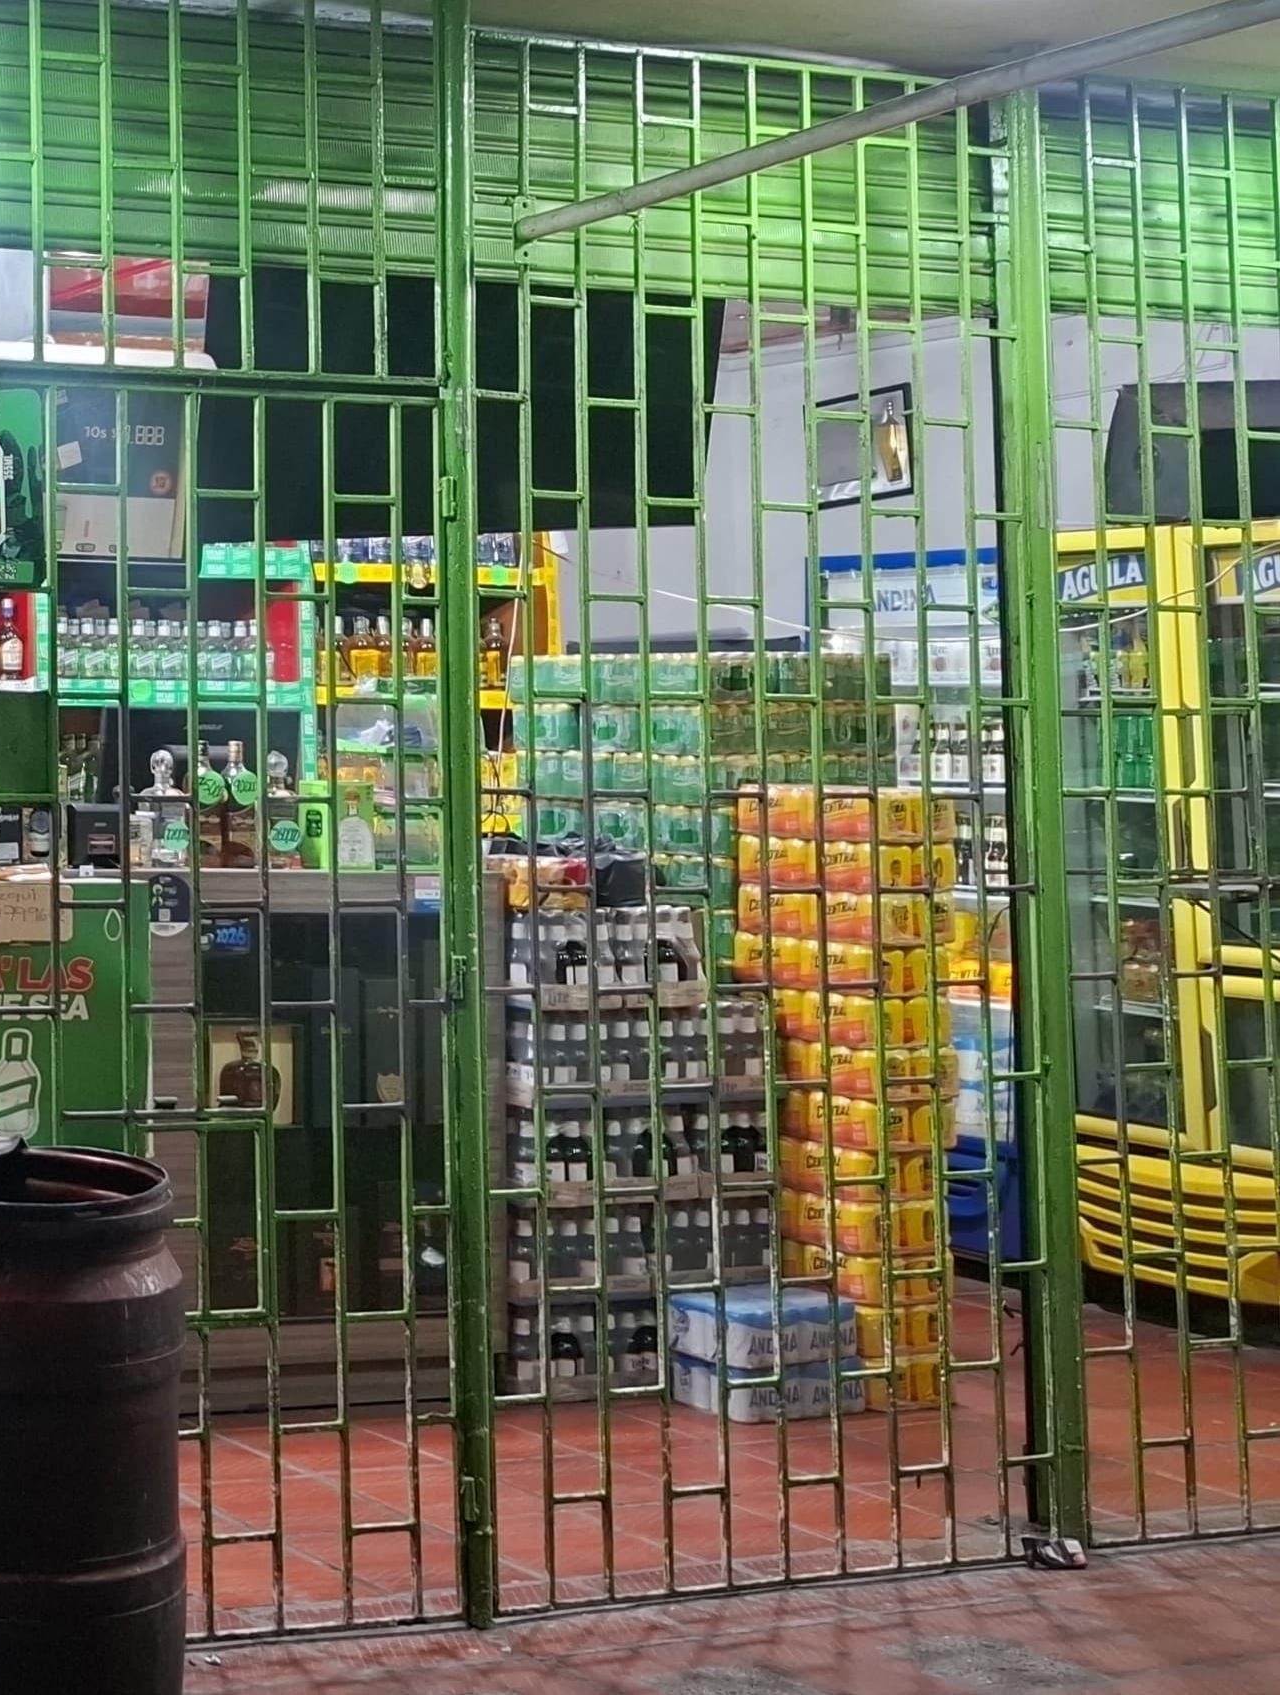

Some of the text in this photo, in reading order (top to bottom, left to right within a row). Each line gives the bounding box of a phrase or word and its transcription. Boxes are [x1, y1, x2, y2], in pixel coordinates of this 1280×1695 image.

[873, 583, 937, 613] NDIA
[747, 1328, 799, 1356] ANDNA
[809, 1326, 856, 1351] ANNA
[749, 1385, 800, 1409] ANDNA
[812, 1380, 863, 1405] ANNA
